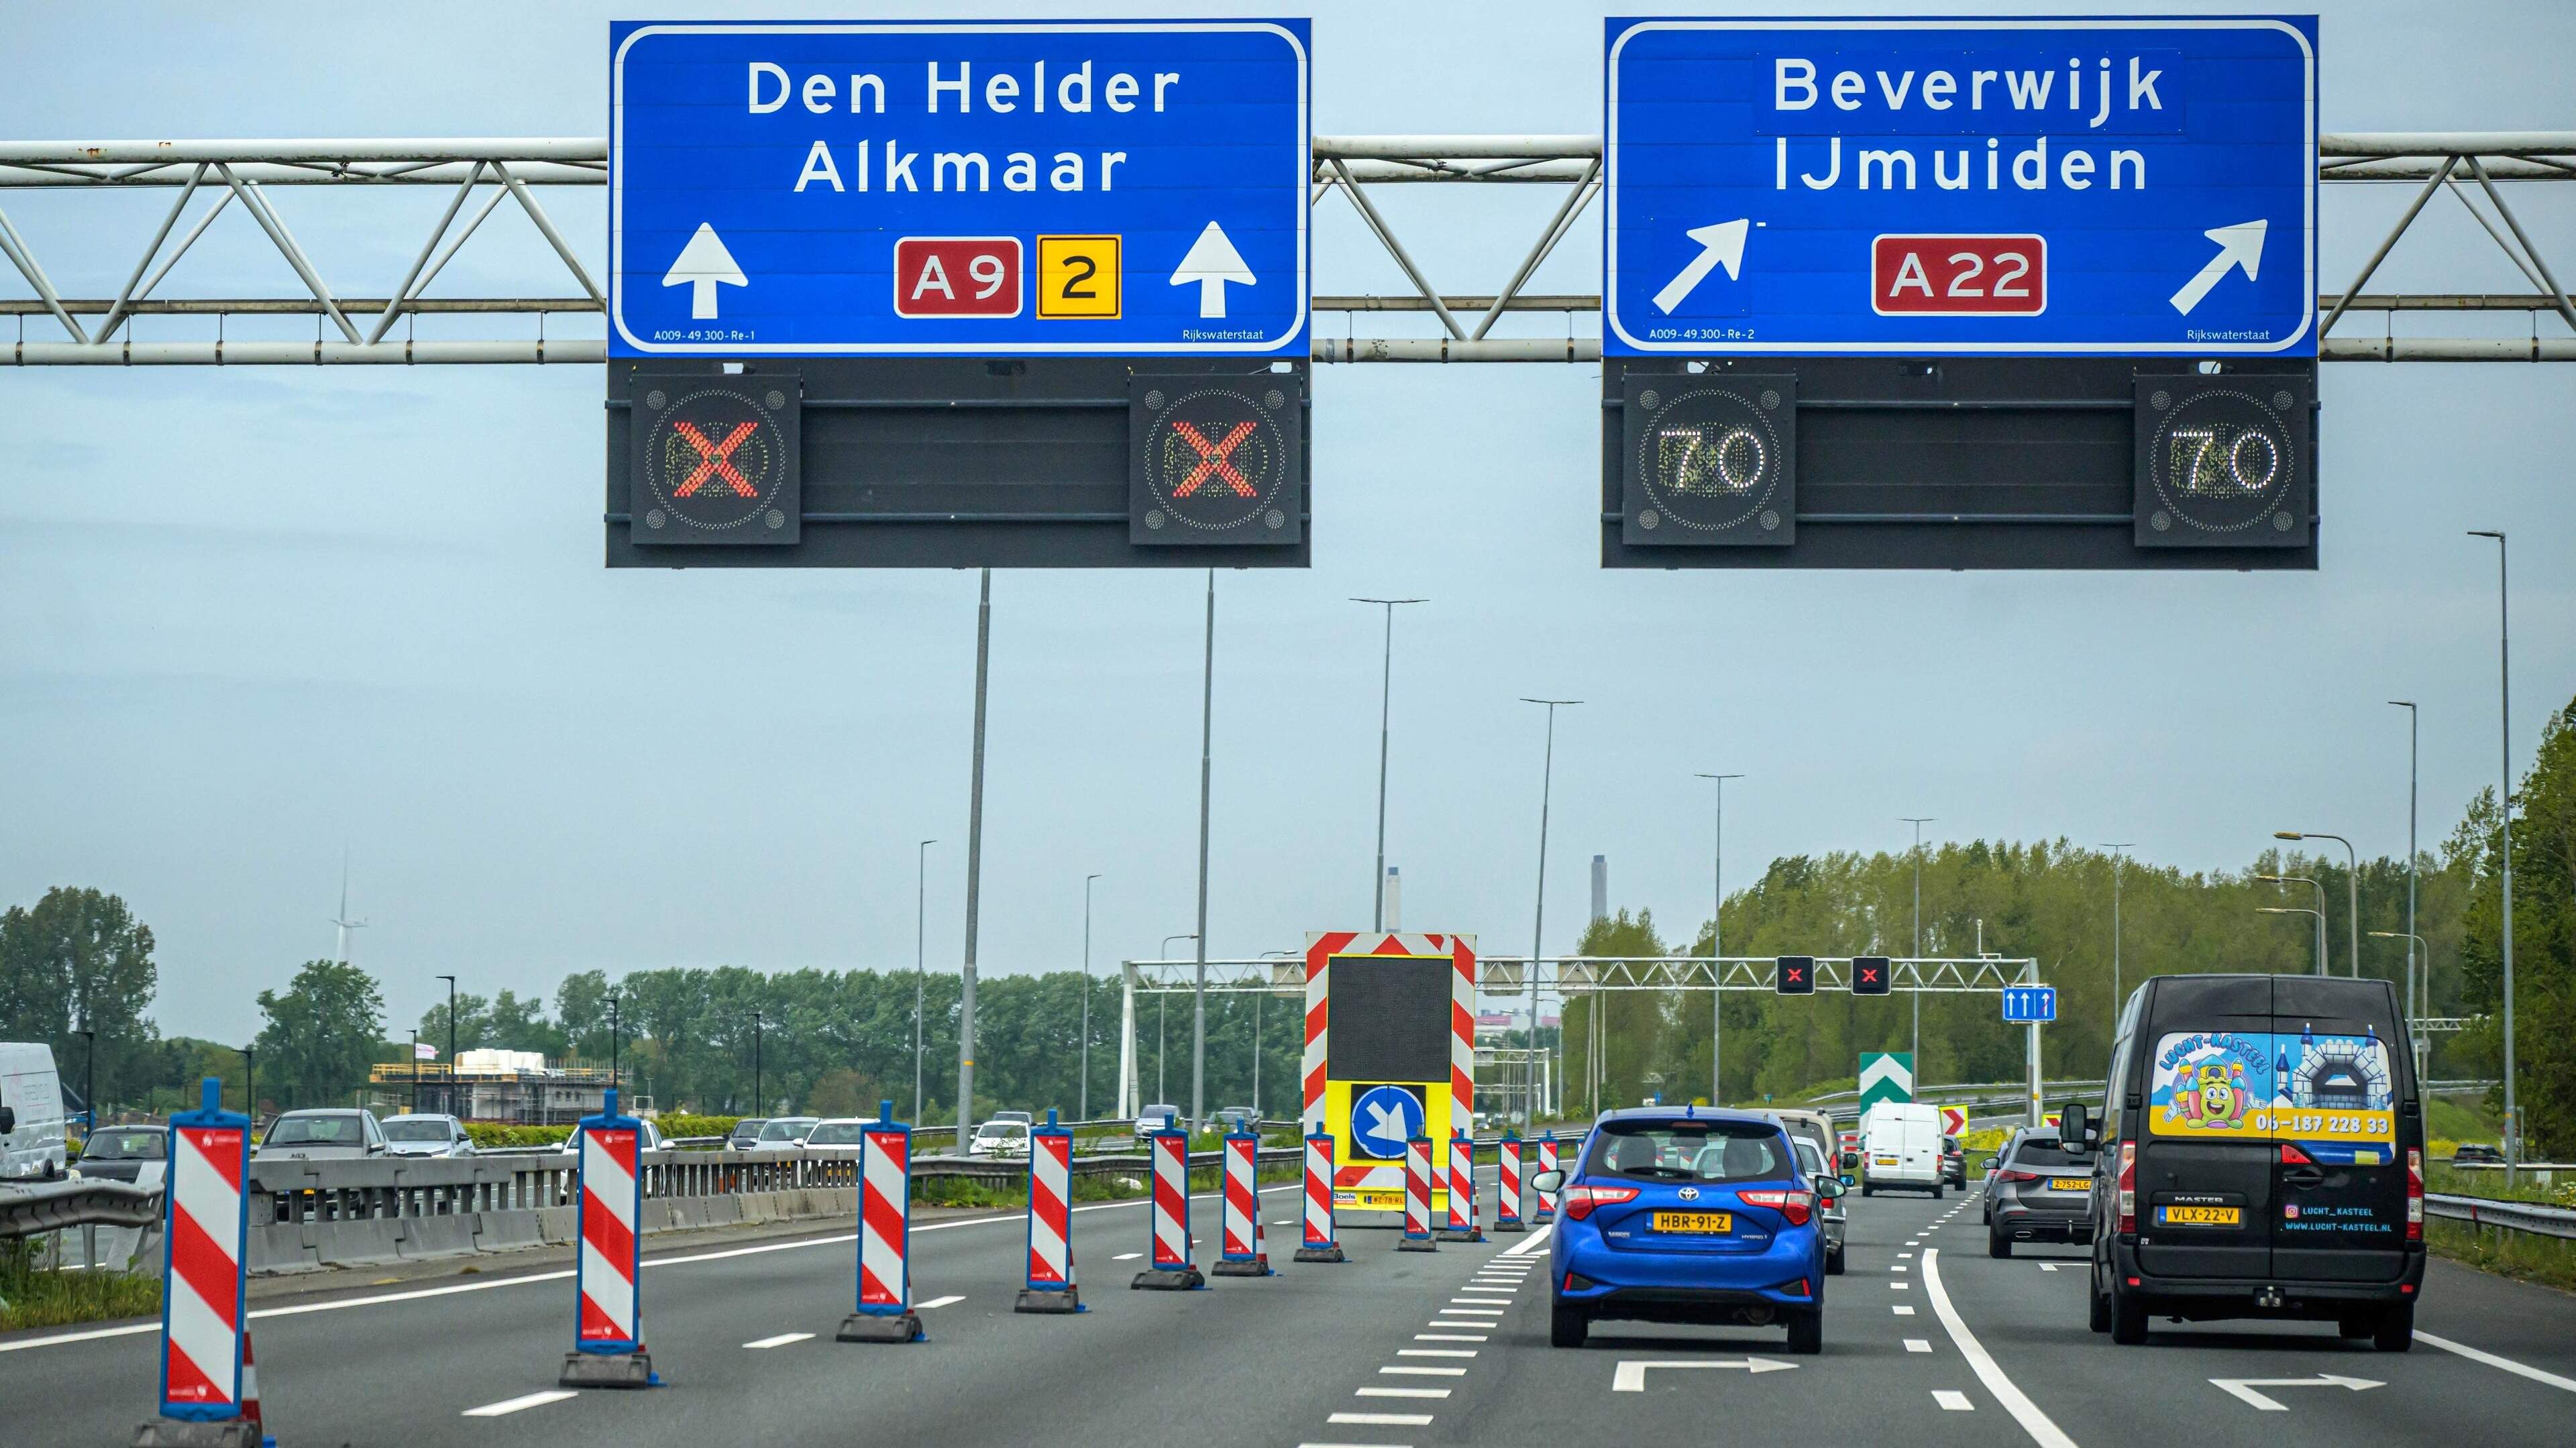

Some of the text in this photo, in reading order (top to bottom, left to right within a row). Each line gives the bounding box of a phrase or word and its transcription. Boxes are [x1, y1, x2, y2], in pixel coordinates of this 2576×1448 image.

[749, 59, 1180, 114] Den Helder
[1776, 56, 2163, 128] Beverwijk
[794, 139, 1127, 192] Alkmaar
[1776, 135, 2145, 190] IJmuiden
[1062, 256, 1096, 298] 2
[1889, 252, 2029, 297] A22
[1183, 329, 1263, 342] Rijkswaterstaat
[2187, 329, 2269, 342] Rijkswaterstaat
[1660, 431, 1765, 489] 70
[2172, 431, 2277, 490] 70
[2159, 1032, 2271, 1075] LUCHT-KASTEEL
[2255, 1115, 2389, 1134] 06-187 228 33
[1660, 1214, 1725, 1229] HBR-91-Z
[2172, 1209, 2234, 1221] VLX-22-V
[2286, 1223, 2392, 1232] WWW.LUCHT-KASTEEL.NL
[2302, 1207, 2373, 1216] LUCHT_KASTEEL
